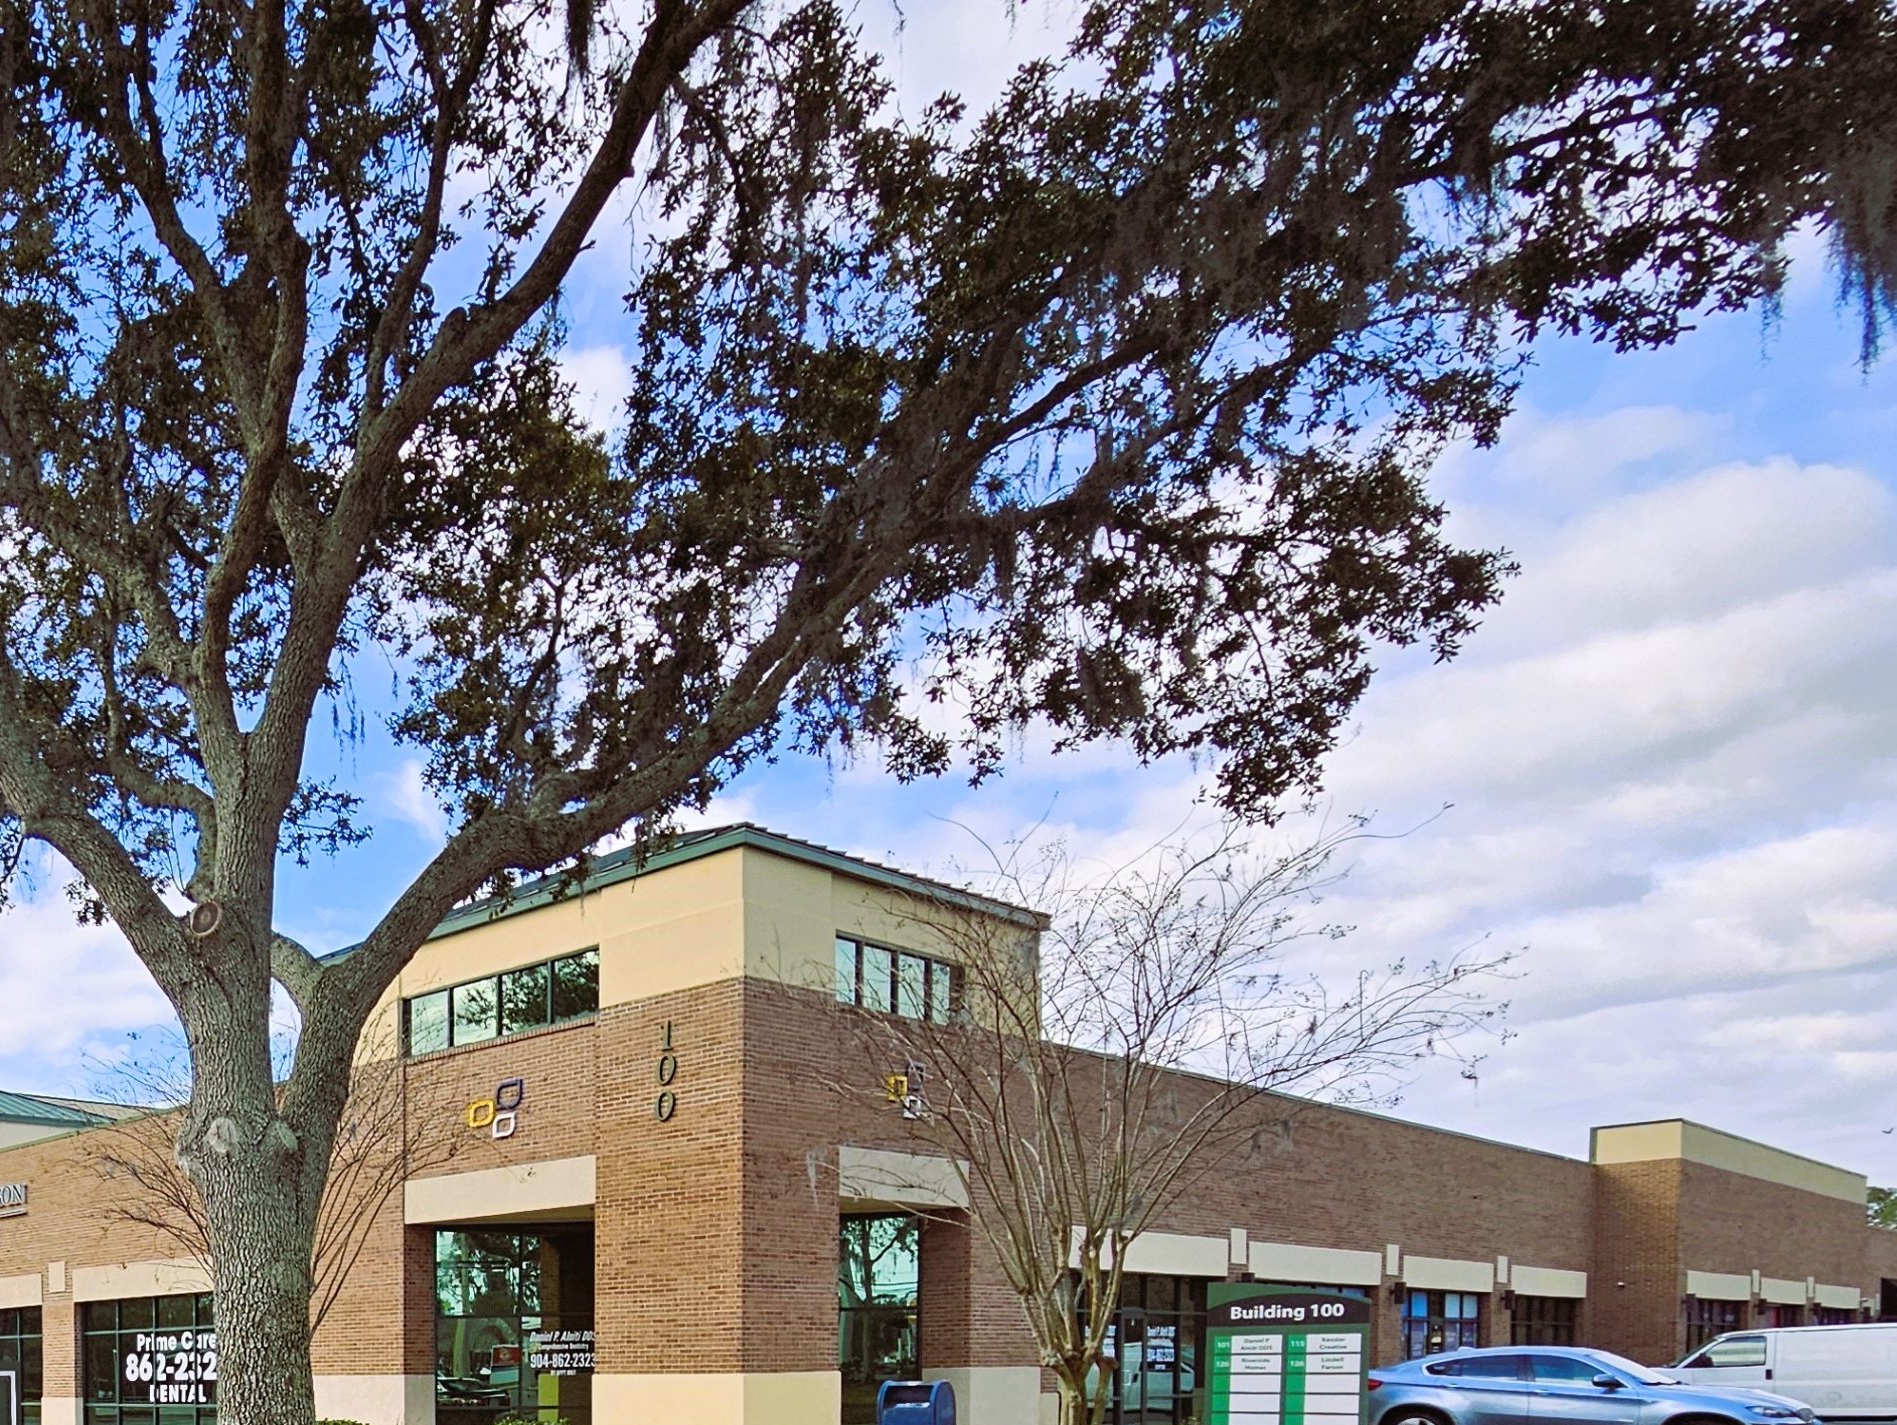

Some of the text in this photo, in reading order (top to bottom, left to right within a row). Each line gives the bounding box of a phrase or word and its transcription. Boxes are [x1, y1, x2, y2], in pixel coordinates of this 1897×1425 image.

[654, 1019, 677, 1122] 100
[1230, 1303, 1345, 1321] Building 100
[137, 1333, 177, 1352] Prime
[125, 1351, 218, 1382] 862-232
[149, 1383, 207, 1403] DENTAL
